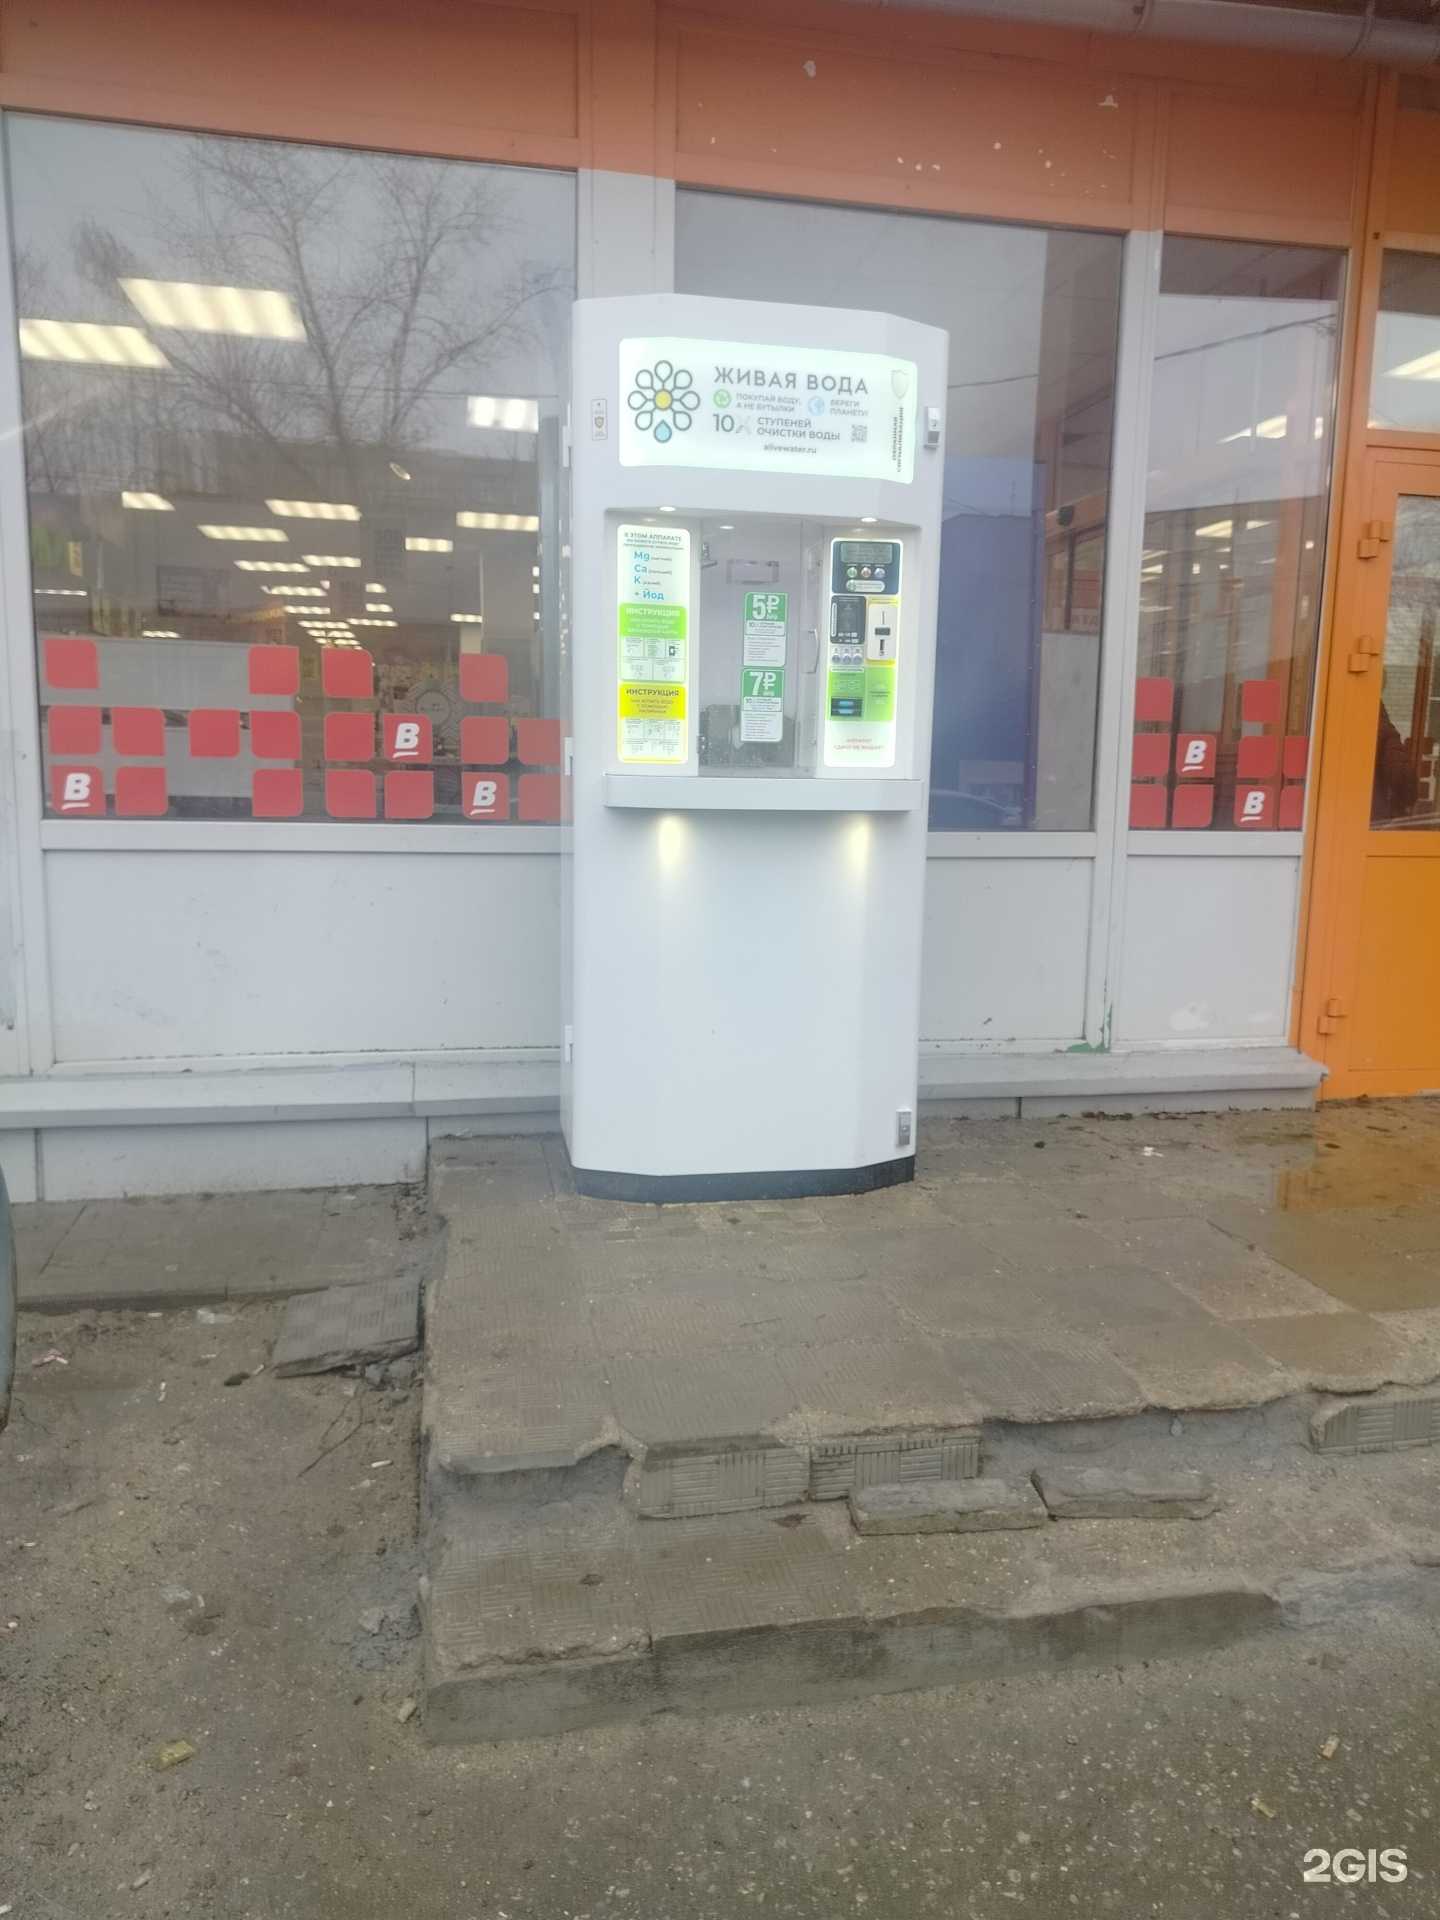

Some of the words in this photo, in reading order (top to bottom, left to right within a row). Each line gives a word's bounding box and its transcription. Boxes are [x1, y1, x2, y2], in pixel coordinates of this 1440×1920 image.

[714, 366, 797, 389] ЖИВАЯ
[807, 374, 868, 396] ВОДА
[736, 392, 776, 402] ПОКУПАЙ
[743, 402, 754, 410] НЕ
[756, 403, 794, 412] БУТЫЛКИ
[712, 413, 735, 433] 10
[757, 416, 812, 429] СТУПЕНЕЙ
[756, 427, 806, 439] ОЧИСТКИ
[809, 431, 841, 442] ВОДЫ
[633, 551, 650, 562] Mg
[642, 588, 664, 601] Йод
[626, 687, 680, 697] ИНСТРУКЦИЯ
